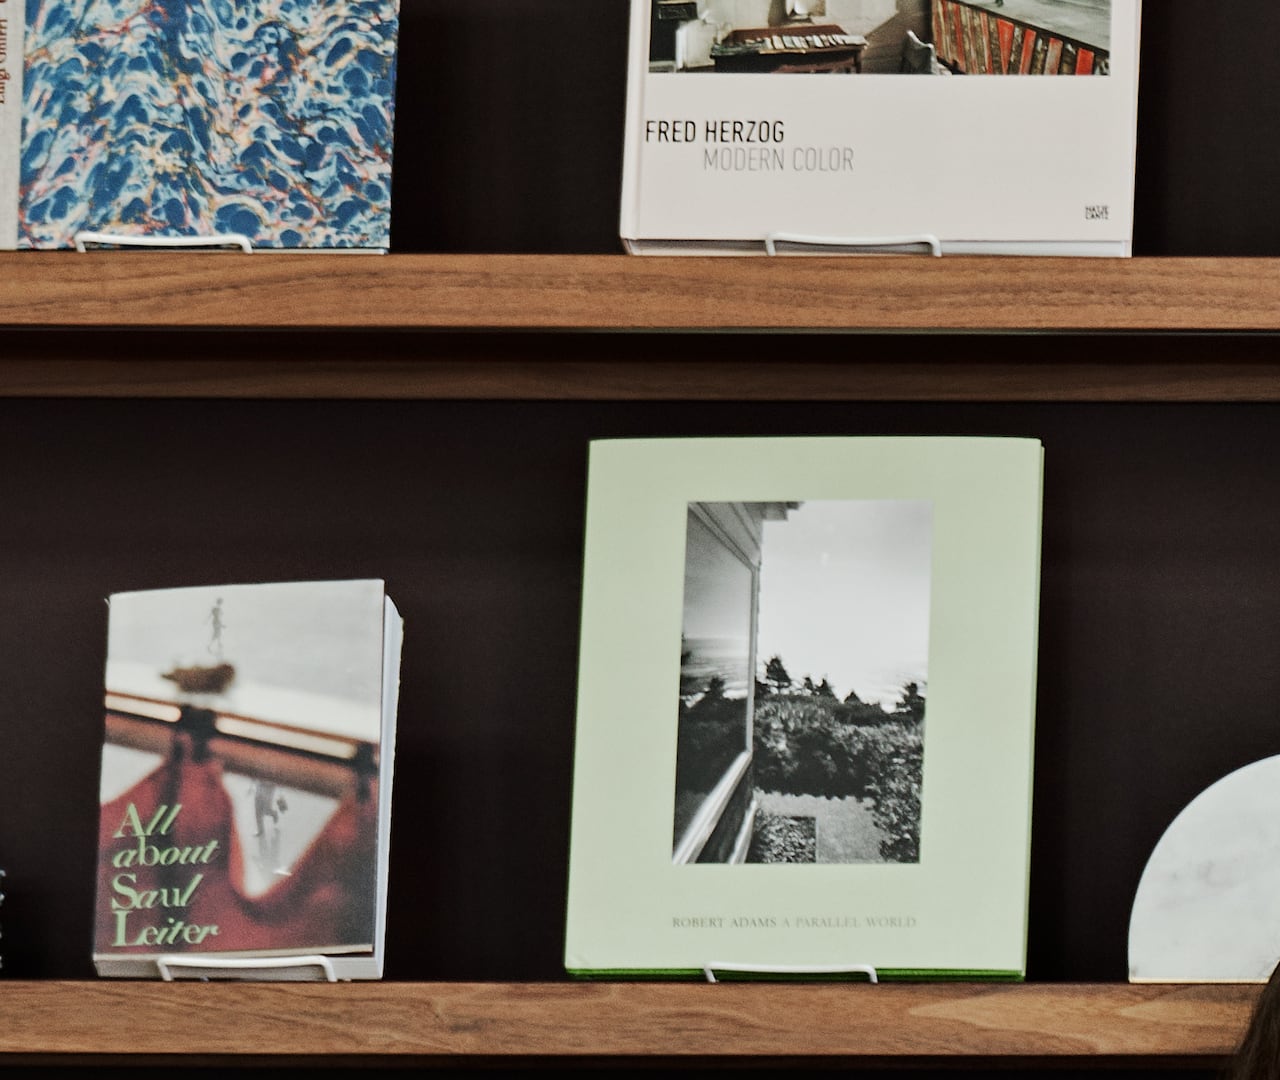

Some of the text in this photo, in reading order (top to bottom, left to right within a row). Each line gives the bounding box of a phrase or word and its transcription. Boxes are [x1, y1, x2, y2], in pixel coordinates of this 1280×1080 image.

[646, 120, 785, 143] FRED HERZOG
[703, 147, 854, 172] MODERN COLOR
[111, 803, 183, 839] All
[111, 835, 219, 868] about
[111, 872, 204, 910] Saul
[111, 910, 219, 947] Leiter
[671, 916, 724, 929] ROBERT
[729, 916, 778, 929] ADAMS
[795, 916, 862, 929] PARALLEL
[865, 916, 917, 929] WORLD
